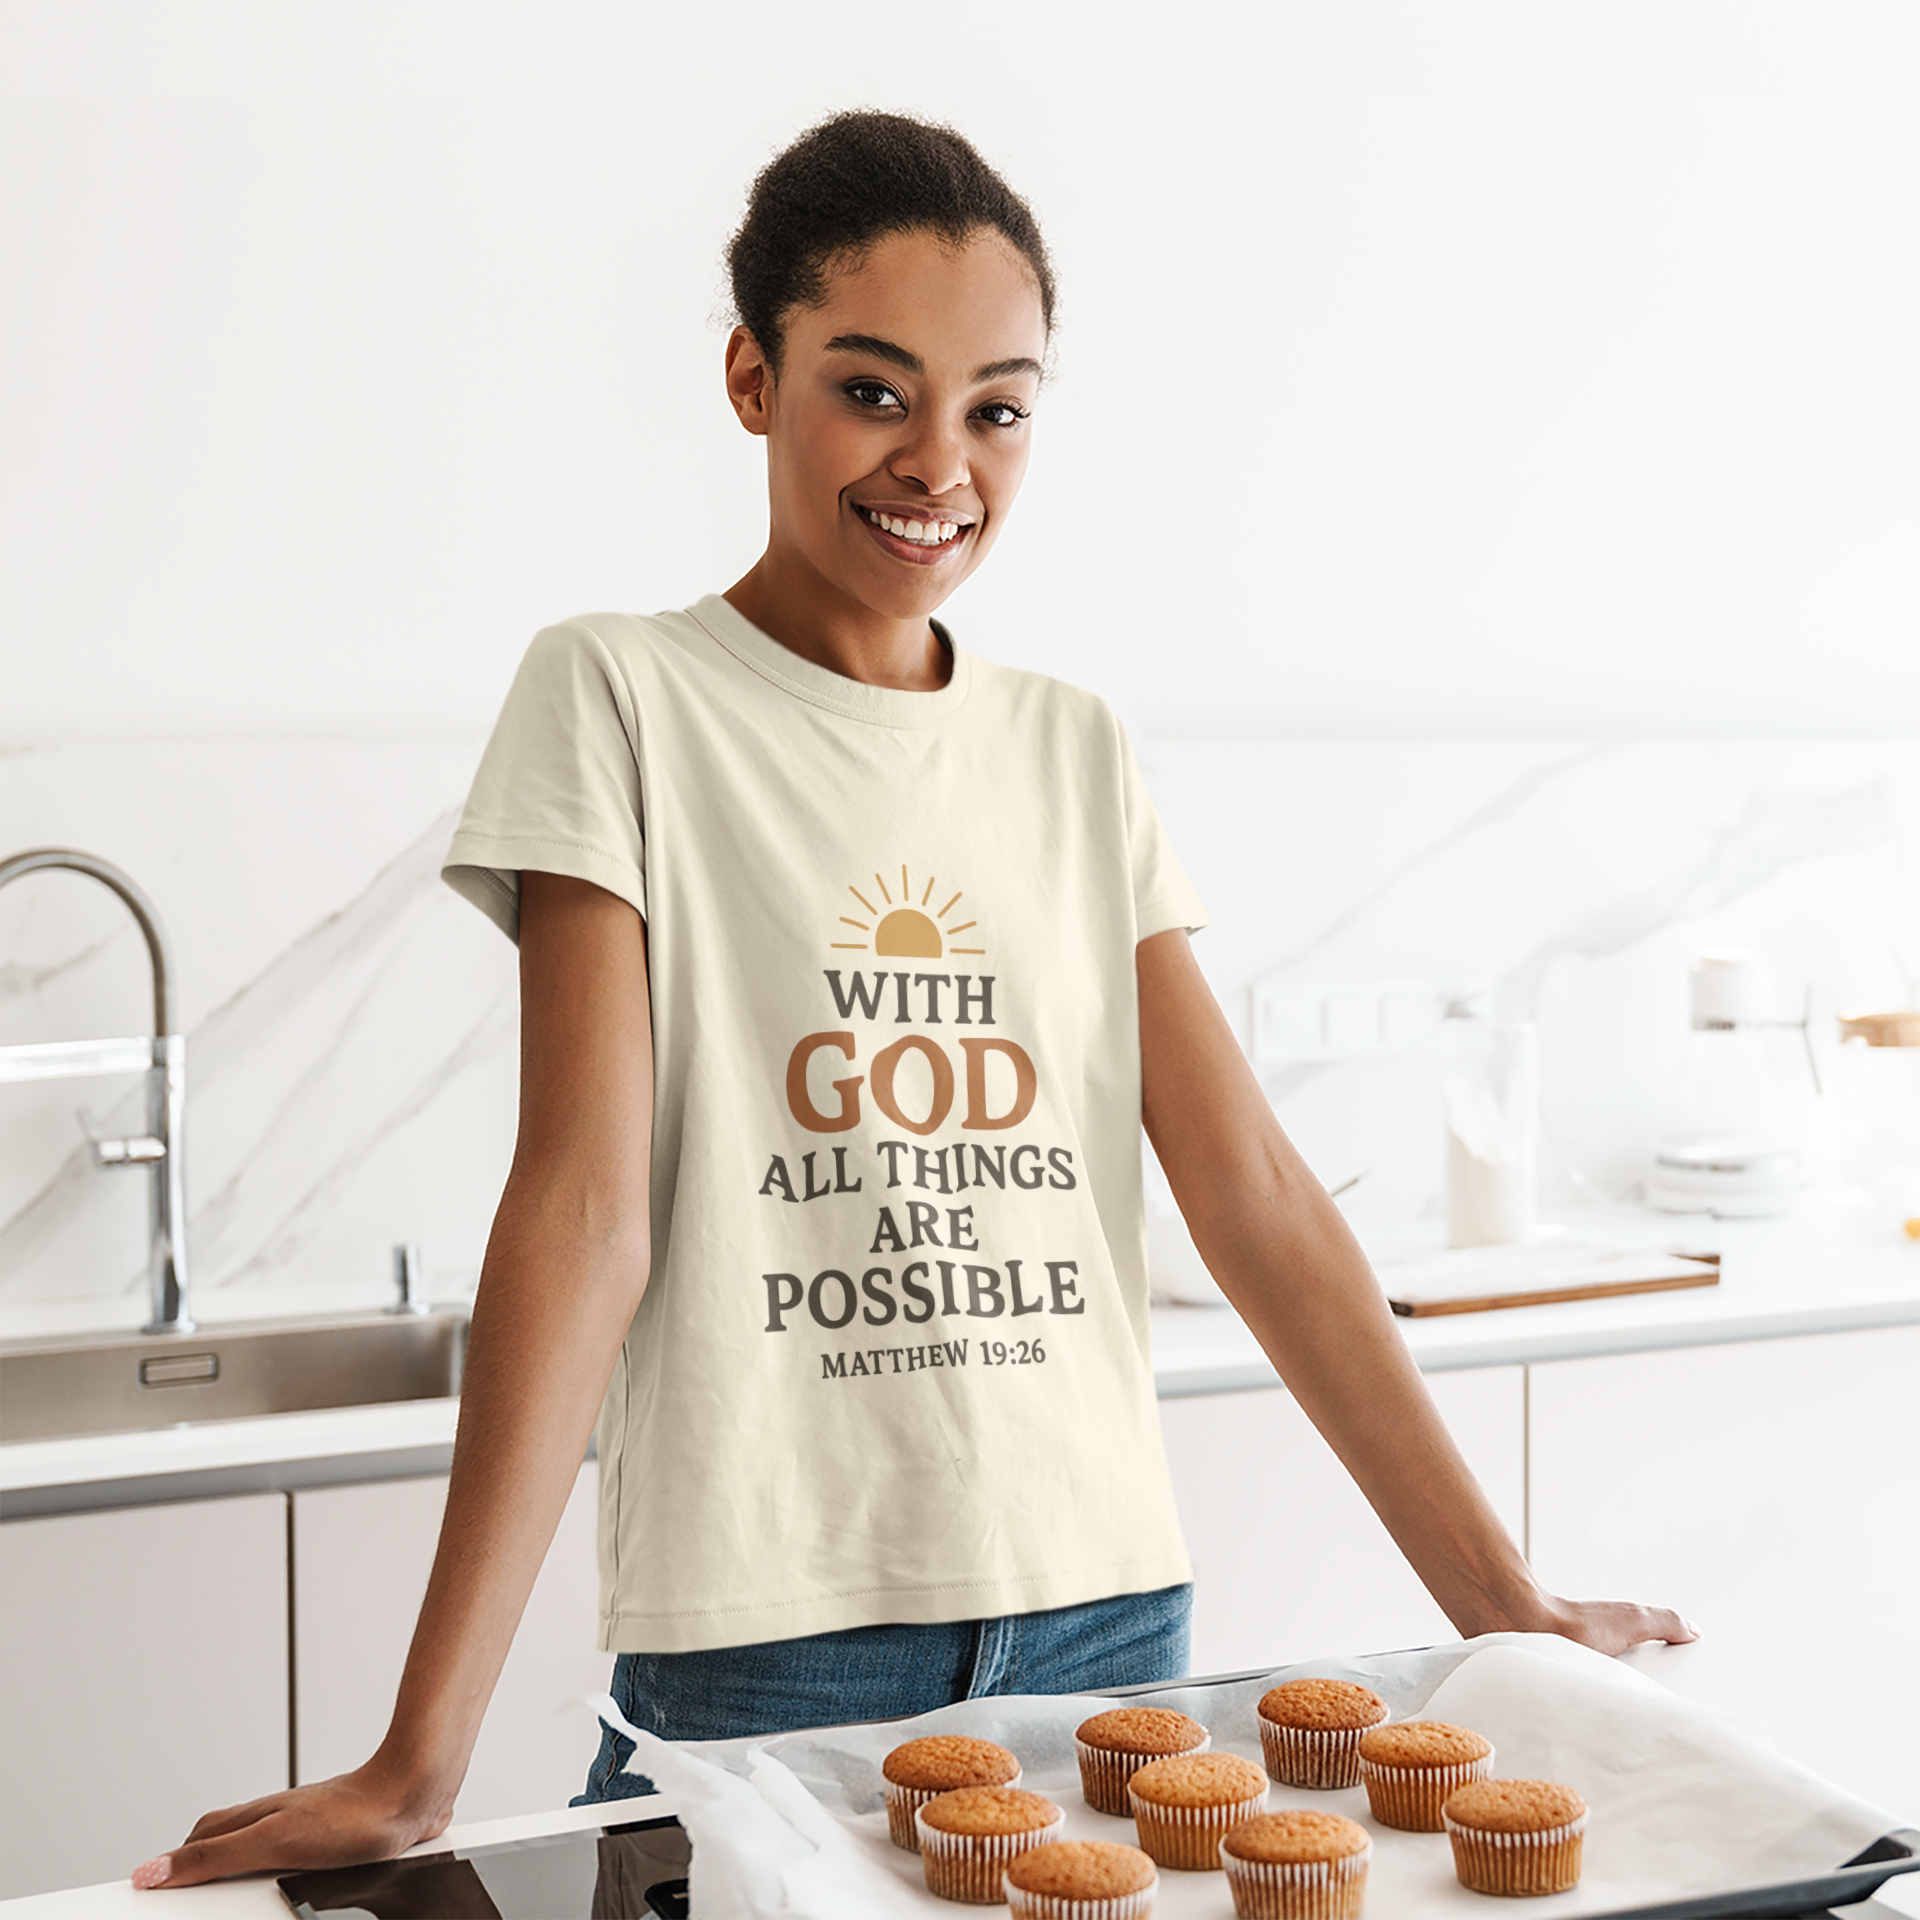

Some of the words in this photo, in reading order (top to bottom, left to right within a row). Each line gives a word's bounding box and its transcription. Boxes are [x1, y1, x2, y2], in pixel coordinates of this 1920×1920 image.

[823, 969, 996, 1025] WITH
[786, 1031, 1037, 1136] GOD
[758, 1146, 863, 1204] ALL
[876, 1141, 1077, 1195] THINGS
[868, 1201, 980, 1254] ARE
[762, 1260, 1085, 1333] POSSIBLE
[820, 1338, 969, 1380] MATTHEW
[979, 1338, 1046, 1367] 19:26
